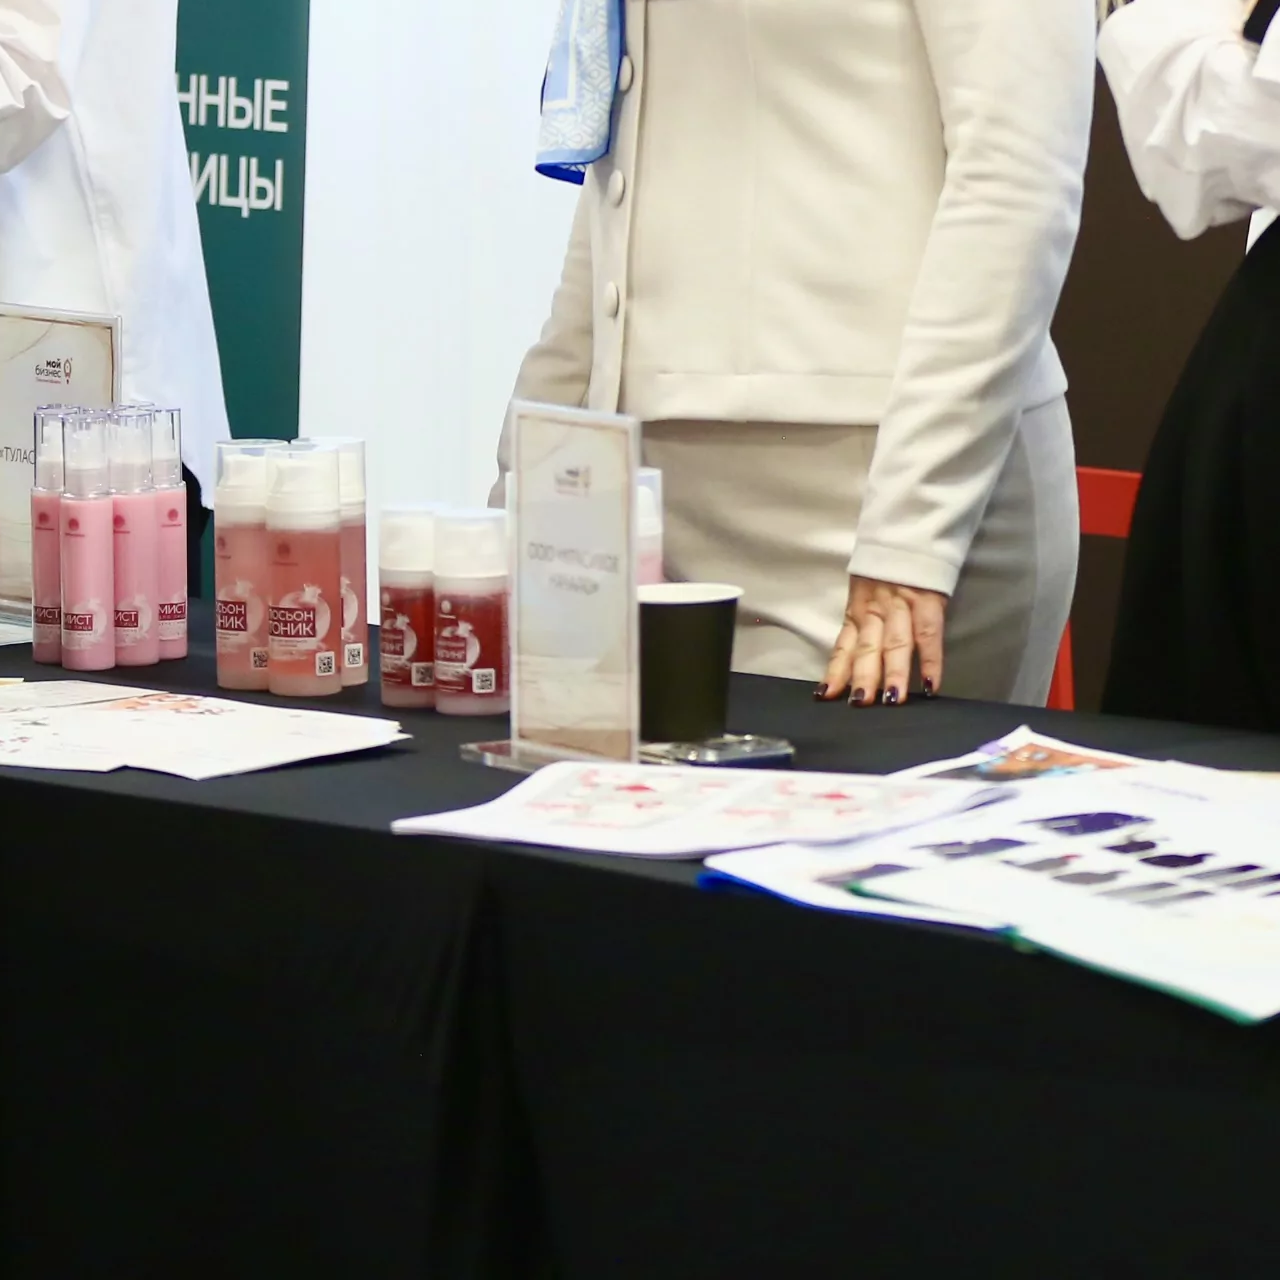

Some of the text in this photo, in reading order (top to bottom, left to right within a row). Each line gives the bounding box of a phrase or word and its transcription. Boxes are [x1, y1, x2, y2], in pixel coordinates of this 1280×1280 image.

[187, 150, 285, 218] ИЦЫ
[35, 364, 61, 378] бизнес
[114, 611, 137, 622] ИСТ
